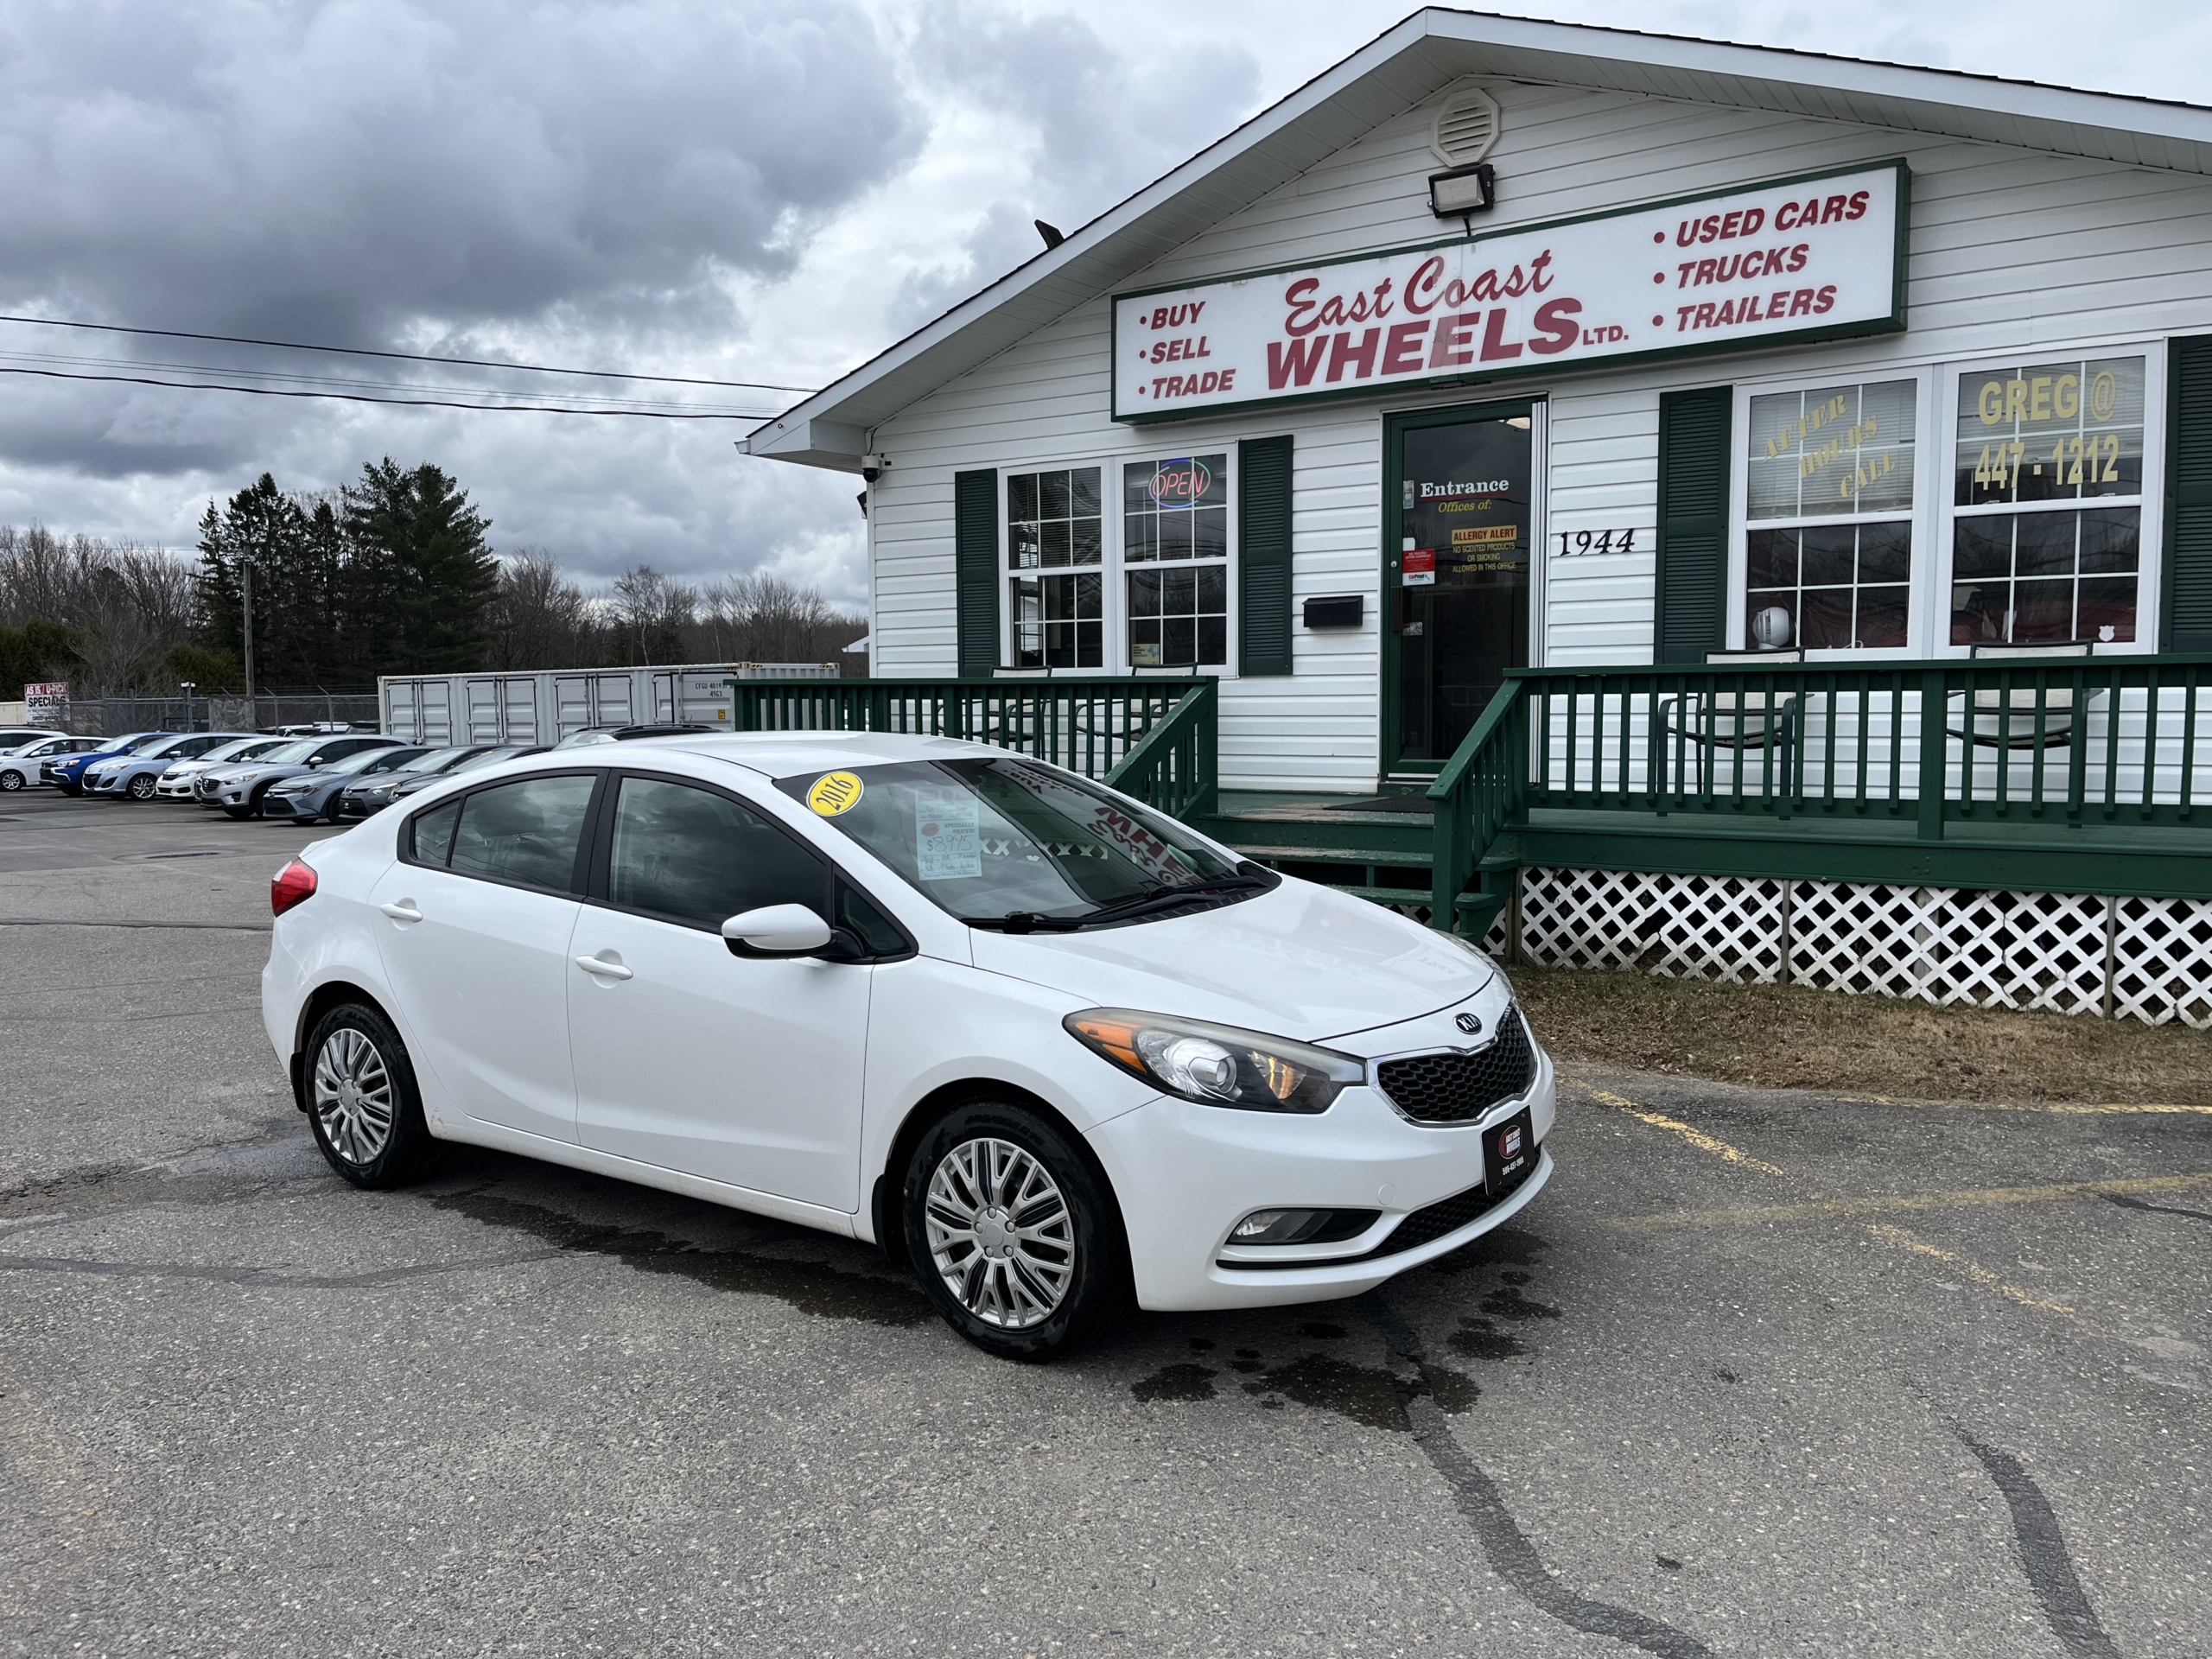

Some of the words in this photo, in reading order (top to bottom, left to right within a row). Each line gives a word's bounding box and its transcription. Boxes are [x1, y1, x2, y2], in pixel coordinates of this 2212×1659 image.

[1676, 208, 1765, 247] USED
[1774, 190, 1870, 231] CARS
[1677, 243, 1809, 289] TRUCKS
[1285, 277, 1394, 337] East
[1403, 249, 1554, 315] Coast
[1151, 301, 1206, 330] BUY
[1677, 285, 1837, 332] TRAILERS
[1150, 336, 1211, 364] SELL
[1267, 297, 1583, 390] WHEELS
[1582, 326, 1630, 345] LTD.
[1152, 369, 1236, 399] TRADE
[1979, 374, 2078, 425] GREG
[2091, 371, 2116, 422] @
[1764, 394, 1848, 463] AFTER
[1800, 414, 1878, 480] HOURS
[1840, 451, 1896, 498] CALL
[1974, 442, 2024, 490] 447
[2052, 435, 2119, 486] 1212
[1152, 469, 1205, 497] OPEN
[1421, 480, 1510, 498] Entrance
[1438, 501, 1475, 513] Offices
[1478, 499, 1491, 510] of:
[1453, 530, 1488, 542] ALLERGY
[1490, 528, 1515, 539] ALERT
[1462, 544, 1486, 553] SCENTED
[1487, 542, 1516, 551] PRODUCTS
[1560, 528, 1635, 556] 1944
[1452, 563, 1477, 573] ALLOWED
[1497, 562, 1516, 570] OFFICE
[1476, 553, 1501, 562] SMOKING
[26, 685, 35, 695] AS
[35, 685, 41, 695] IS
[816, 775, 854, 810] 2016
[1458, 1014, 1480, 1031] KIA
